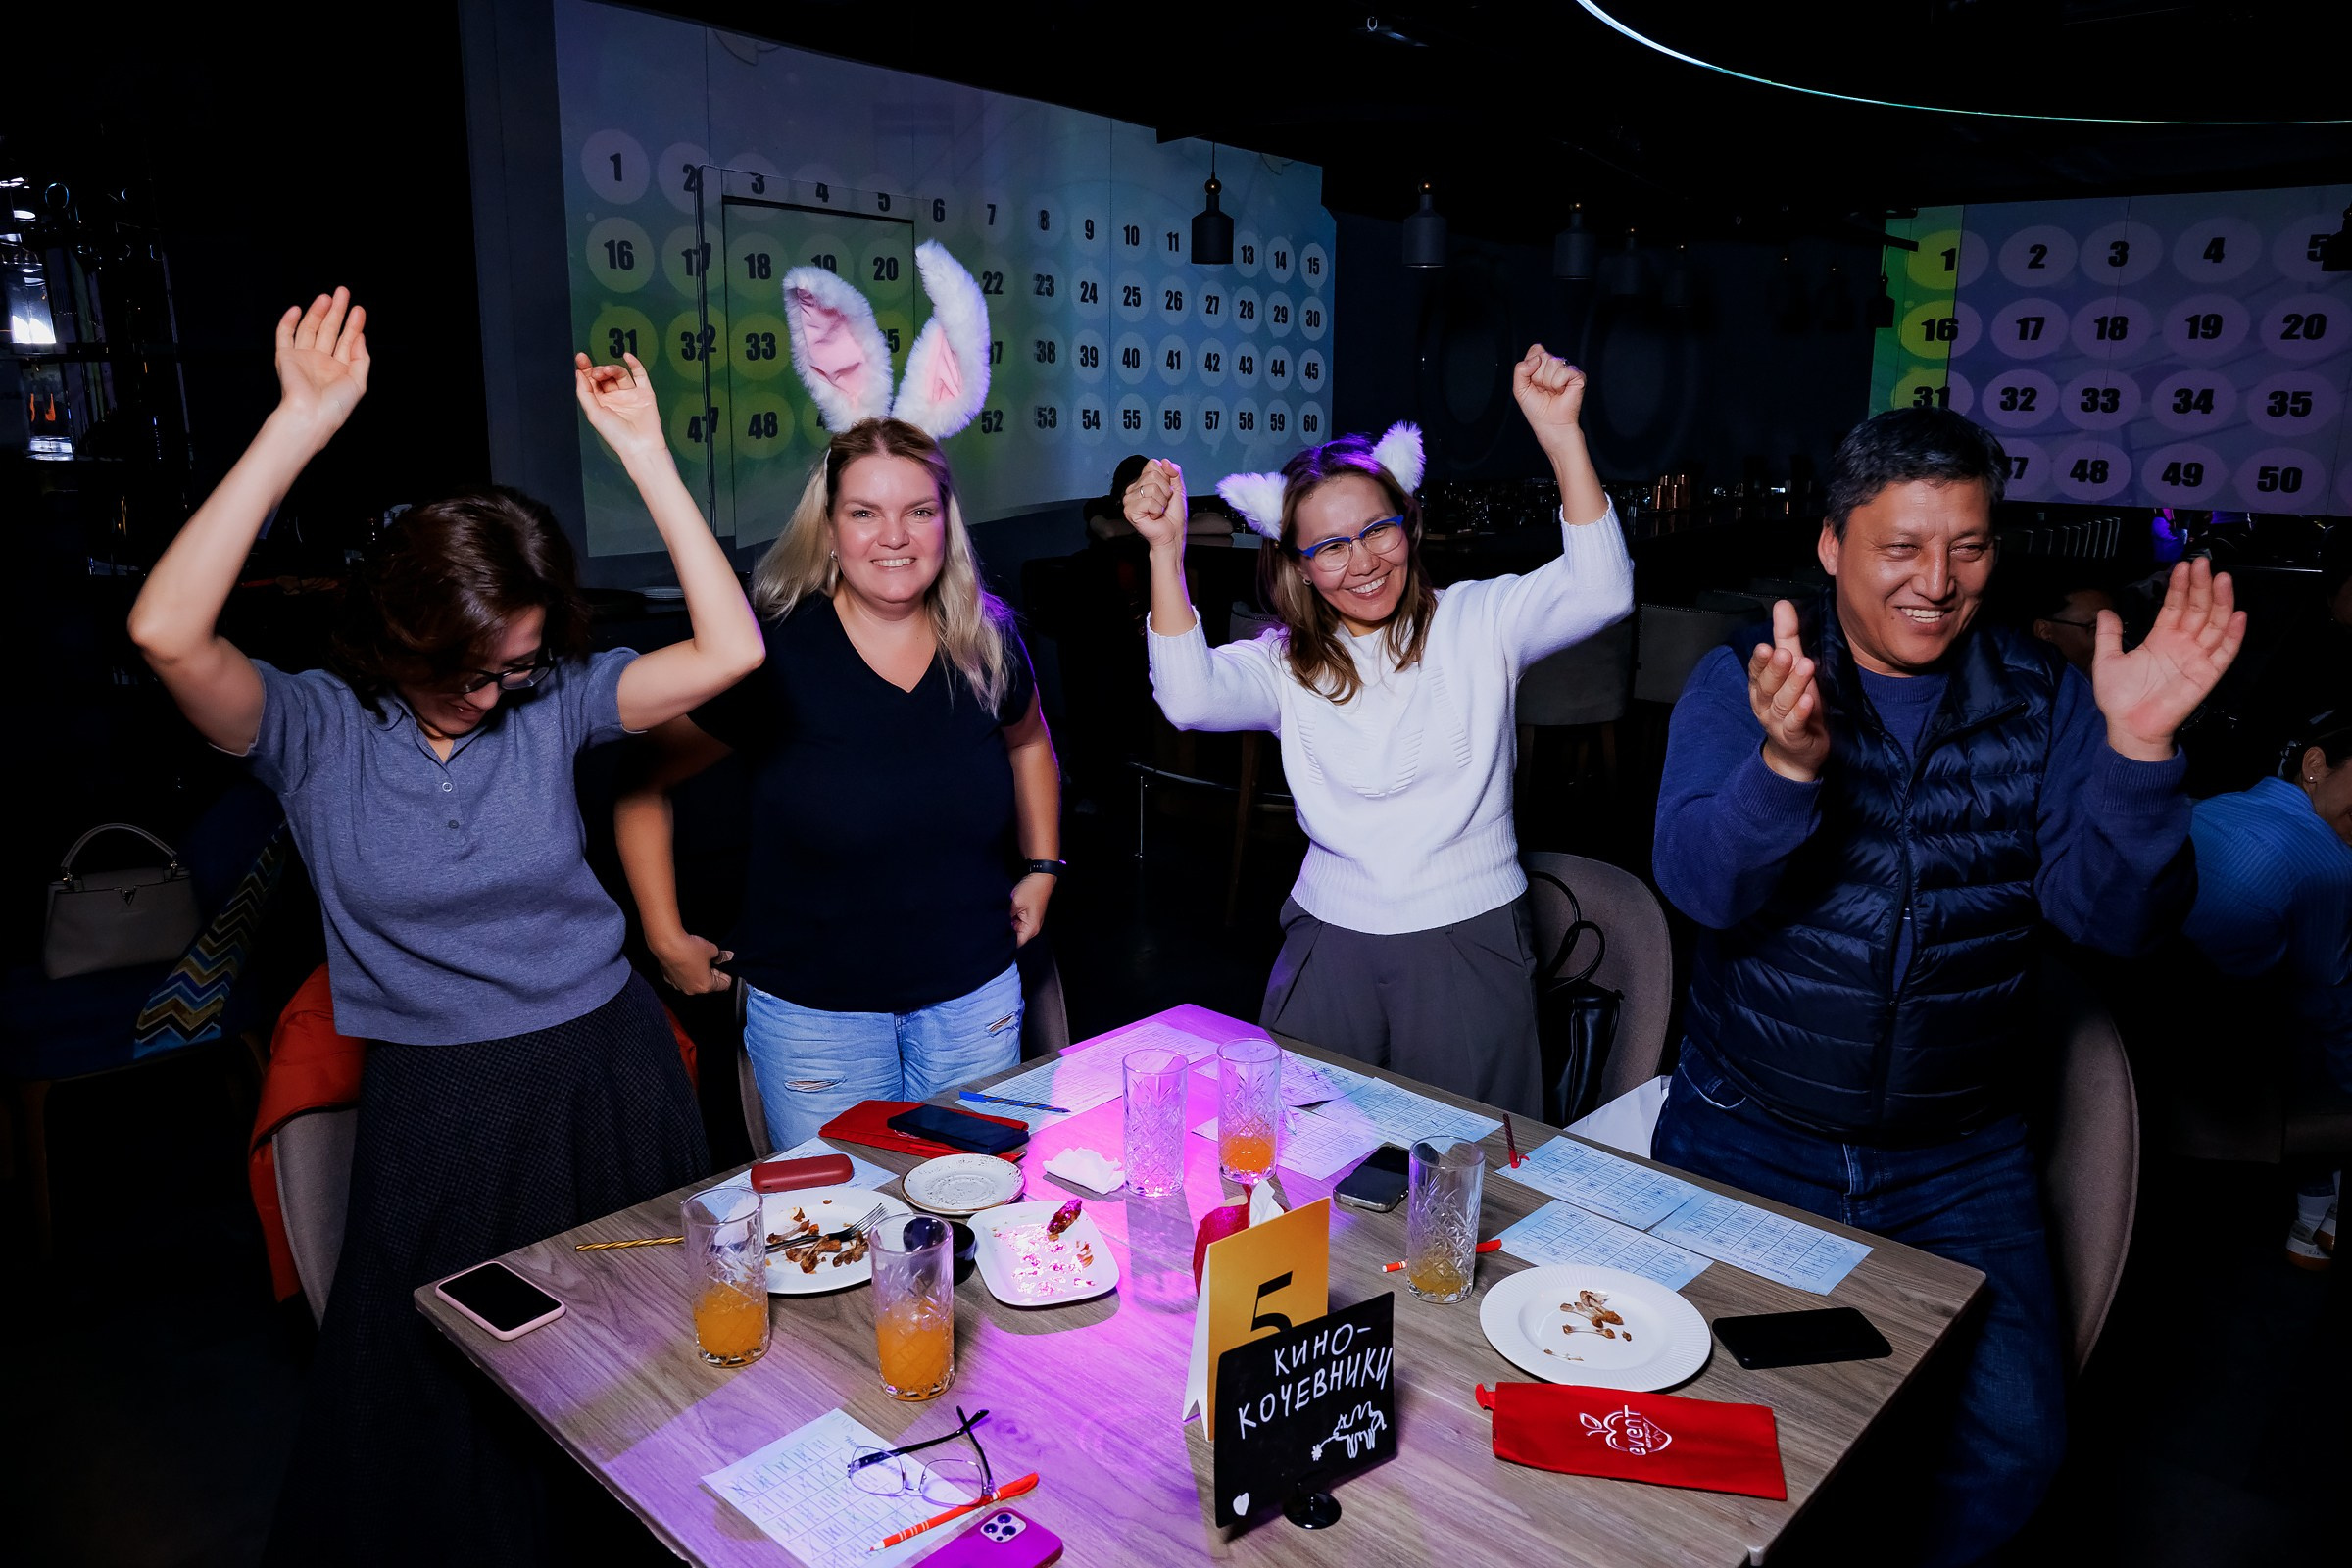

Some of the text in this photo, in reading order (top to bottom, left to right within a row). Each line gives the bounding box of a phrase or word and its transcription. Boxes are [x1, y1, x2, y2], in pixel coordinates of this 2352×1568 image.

[610, 153, 622, 181] 1
[683, 164, 699, 192] 2
[749, 172, 765, 194] 3
[816, 182, 830, 202] 4
[933, 199, 946, 222] 6
[987, 205, 997, 226] 7
[1040, 210, 1050, 230] 8
[1085, 220, 1095, 240] 9
[1124, 225, 1140, 246] 10
[1166, 231, 1179, 252] 11
[1241, 245, 1254, 264] 13
[1274, 251, 1287, 270] 14
[1307, 257, 1320, 275] 15
[1941, 248, 1955, 271] 1
[2028, 245, 2047, 269] 2
[2108, 241, 2129, 267] 3
[2203, 237, 2225, 263] 4
[604, 240, 1320, 328] 16 17 18 19 20 22 23 24 25 26 27 28 29 30
[609, 328, 638, 359] 31
[681, 324, 716, 362] 32
[746, 333, 776, 360] 33
[880, 329, 900, 352] 5
[1035, 341, 1056, 364] 38
[1080, 346, 1099, 368] 39
[1122, 348, 1140, 369] 40
[1166, 350, 1182, 370] 41
[1204, 353, 1220, 372] 42
[1239, 356, 1253, 375] 43
[1271, 359, 1285, 377] 44
[1305, 362, 1318, 380] 45
[1922, 314, 2327, 341] 16 17 18 19 20
[688, 407, 1317, 443] 47 48 52 53 54 55 56 57 58 59 60
[1913, 386, 2312, 416] 31 32 33 34 35
[2007, 457, 2303, 493] 7 48 49 50
[1250, 1270, 1293, 1332] 5
[1274, 1323, 1371, 1376] КИНО-
[1238, 1347, 1393, 1440] КОЧЕВНИКИ
